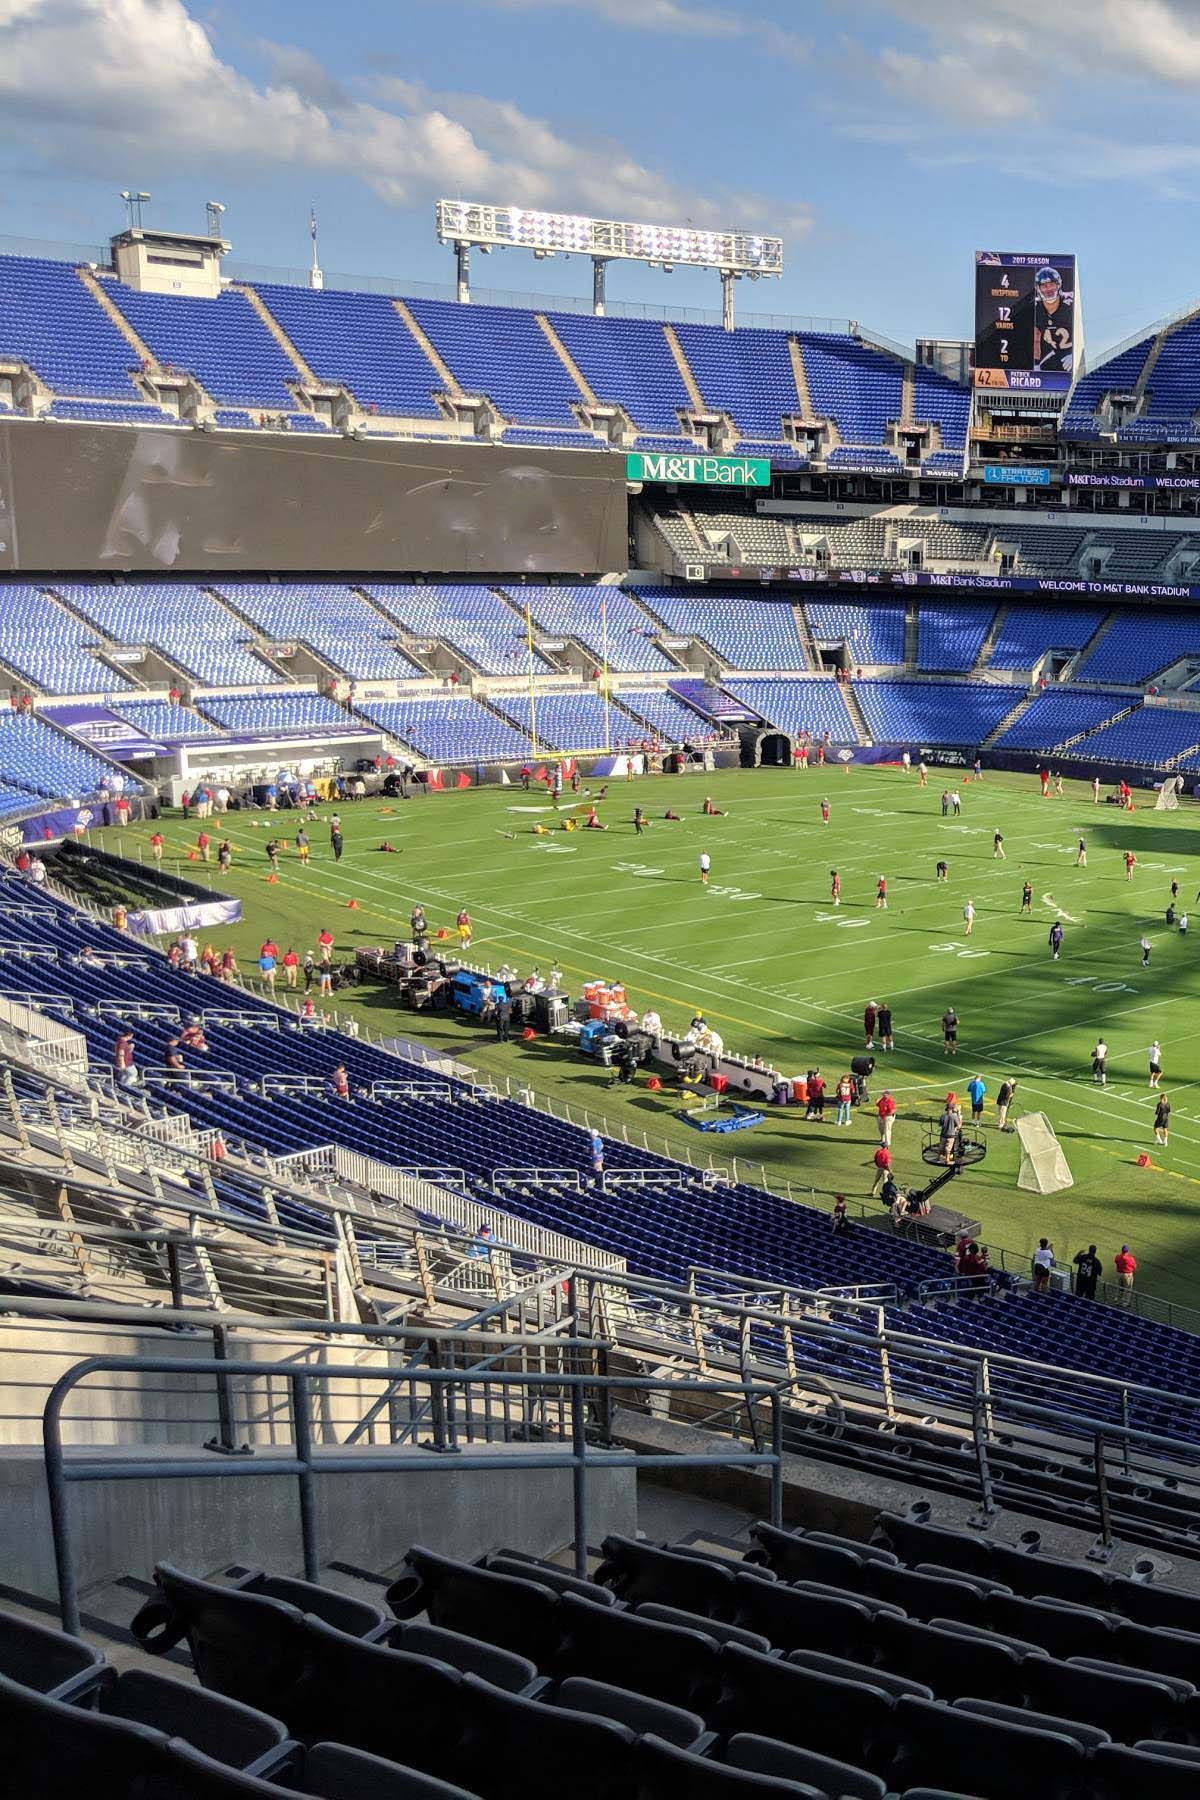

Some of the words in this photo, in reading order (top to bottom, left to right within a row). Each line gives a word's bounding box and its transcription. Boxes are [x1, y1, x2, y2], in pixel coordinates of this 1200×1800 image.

[1012, 256, 1025, 265] 2017
[1027, 257, 1050, 265] SEASON
[1001, 274, 1010, 288] 4
[998, 307, 1011, 321] 12
[1000, 340, 1008, 353] 2
[978, 370, 991, 386] 42
[1011, 378, 1041, 387] RICARD
[642, 455, 702, 481] M&T
[703, 458, 758, 484] Bank
[1001, 475, 1044, 483] FACTORY
[1069, 474, 1090, 485] M&T
[1090, 475, 1111, 485] Bank
[1111, 476, 1144, 486] Stadium
[1156, 478, 1199, 488] WELCOME
[930, 576, 953, 585] M&T
[953, 576, 976, 586] Bank
[976, 577, 1012, 588] Stadium
[1039, 581, 1086, 591] WELCOME
[1088, 582, 1101, 592] TO
[1104, 583, 1123, 592] M&T
[1126, 584, 1149, 594] BANK
[1150, 586, 1190, 596] STADIUM
[706, 885, 762, 900] 30
[813, 911, 871, 928] 40
[928, 942, 992, 958] 50
[1064, 976, 1128, 993] 40
